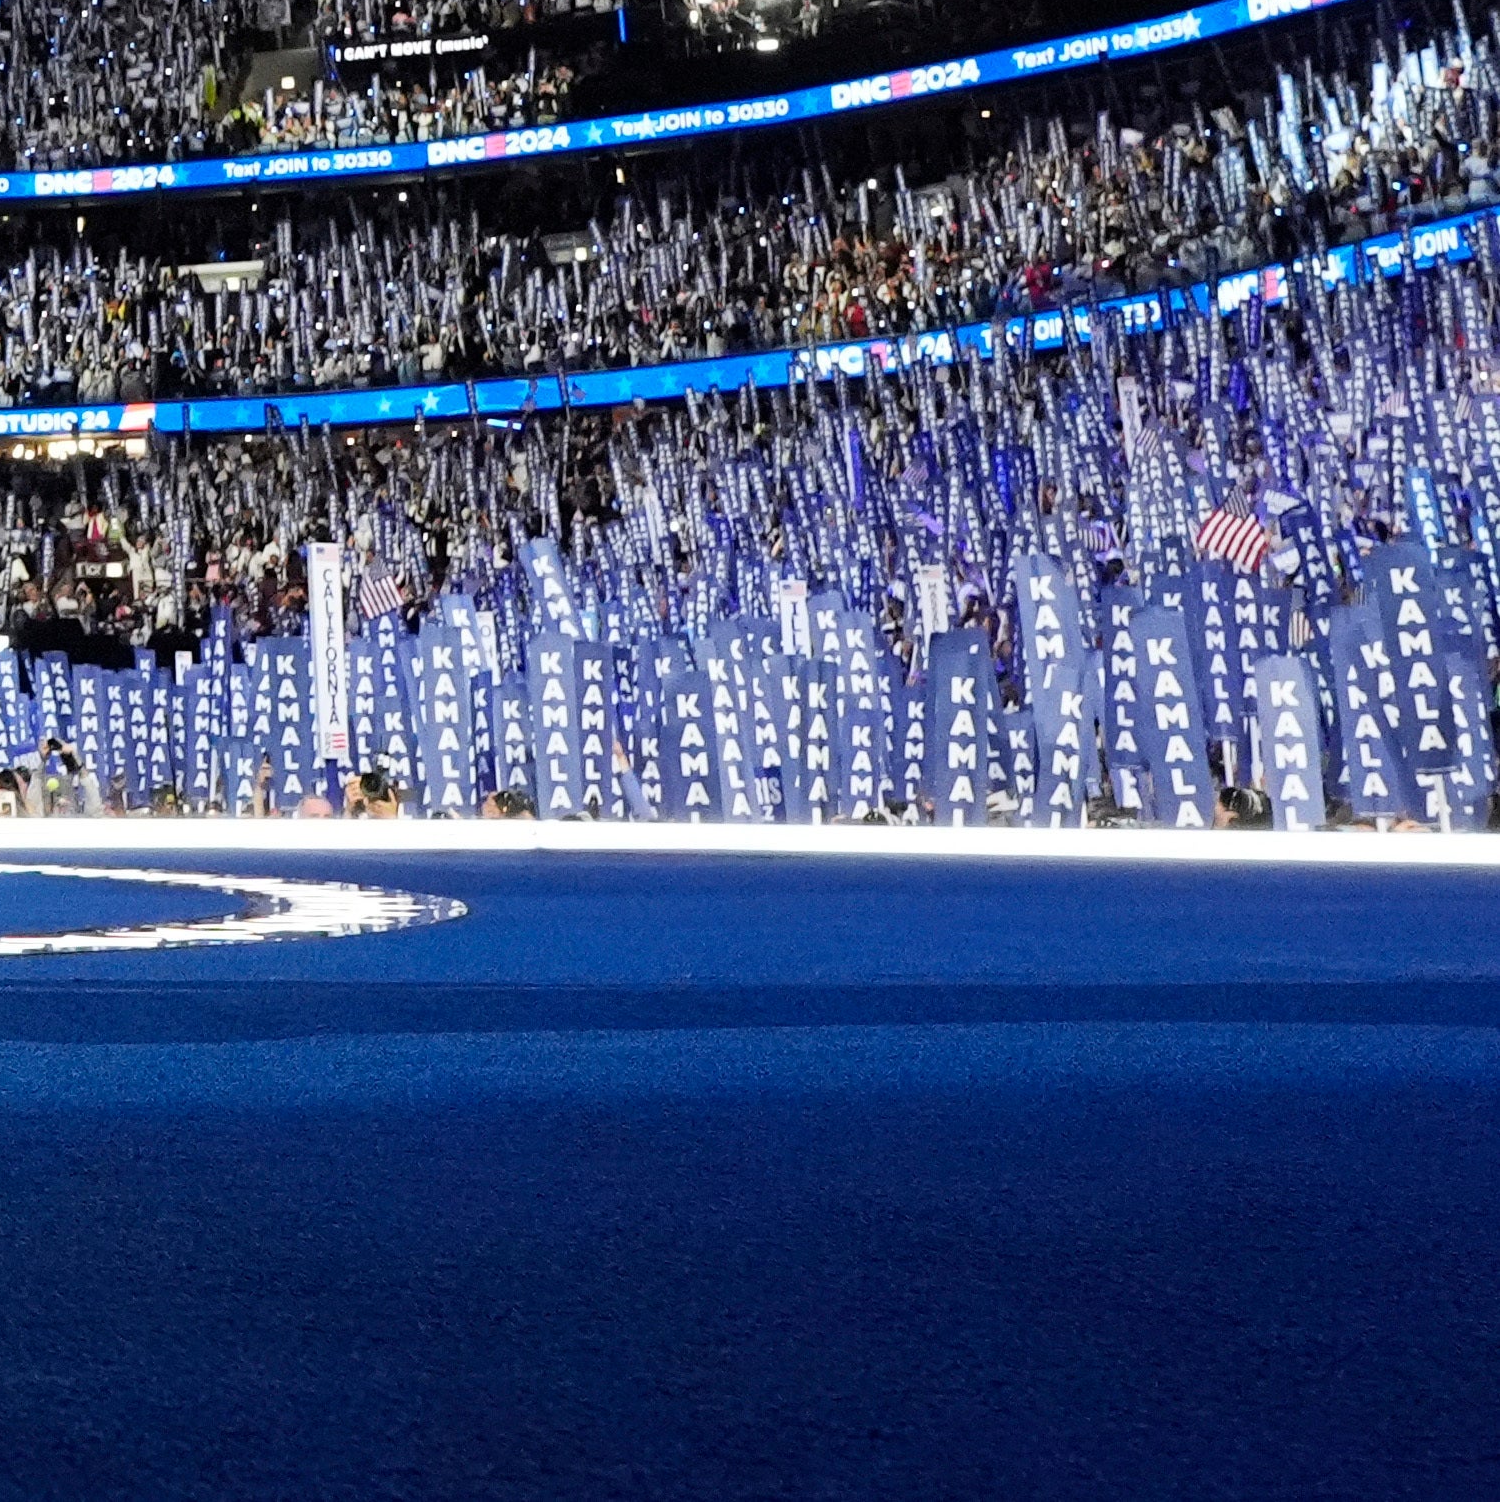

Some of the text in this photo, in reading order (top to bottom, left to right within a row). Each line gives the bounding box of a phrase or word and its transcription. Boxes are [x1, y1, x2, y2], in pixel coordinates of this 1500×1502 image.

[427, 125, 571, 165] DNC 2024
[830, 60, 981, 109] DNC 2024
[34, 165, 176, 196] DNC 2024
[223, 161, 261, 178] Text
[259, 157, 309, 176] JOIN
[311, 157, 331, 171] to
[80, 409, 110, 430] 24
[211, 620, 226, 736] KAMALA
[323, 568, 340, 725] CALIFORNIA
[356, 656, 375, 772] KAMALA
[378, 615, 398, 697] AMALA
[1111, 604, 1138, 752] KAMALA
[1202, 581, 1235, 724] KAMALA
[1389, 567, 1447, 751] KAMALA
[194, 679, 211, 788] KAMALA
[276, 654, 303, 794] KAMALA
[432, 646, 464, 806] KAMALA
[540, 652, 573, 809] KAMALA
[581, 659, 605, 805] KAMALA
[708, 658, 752, 816] KAMALA
[903, 701, 925, 825] KAMALA
[1146, 638, 1204, 828] KAMALA
[1270, 680, 1310, 831] KAMAL
